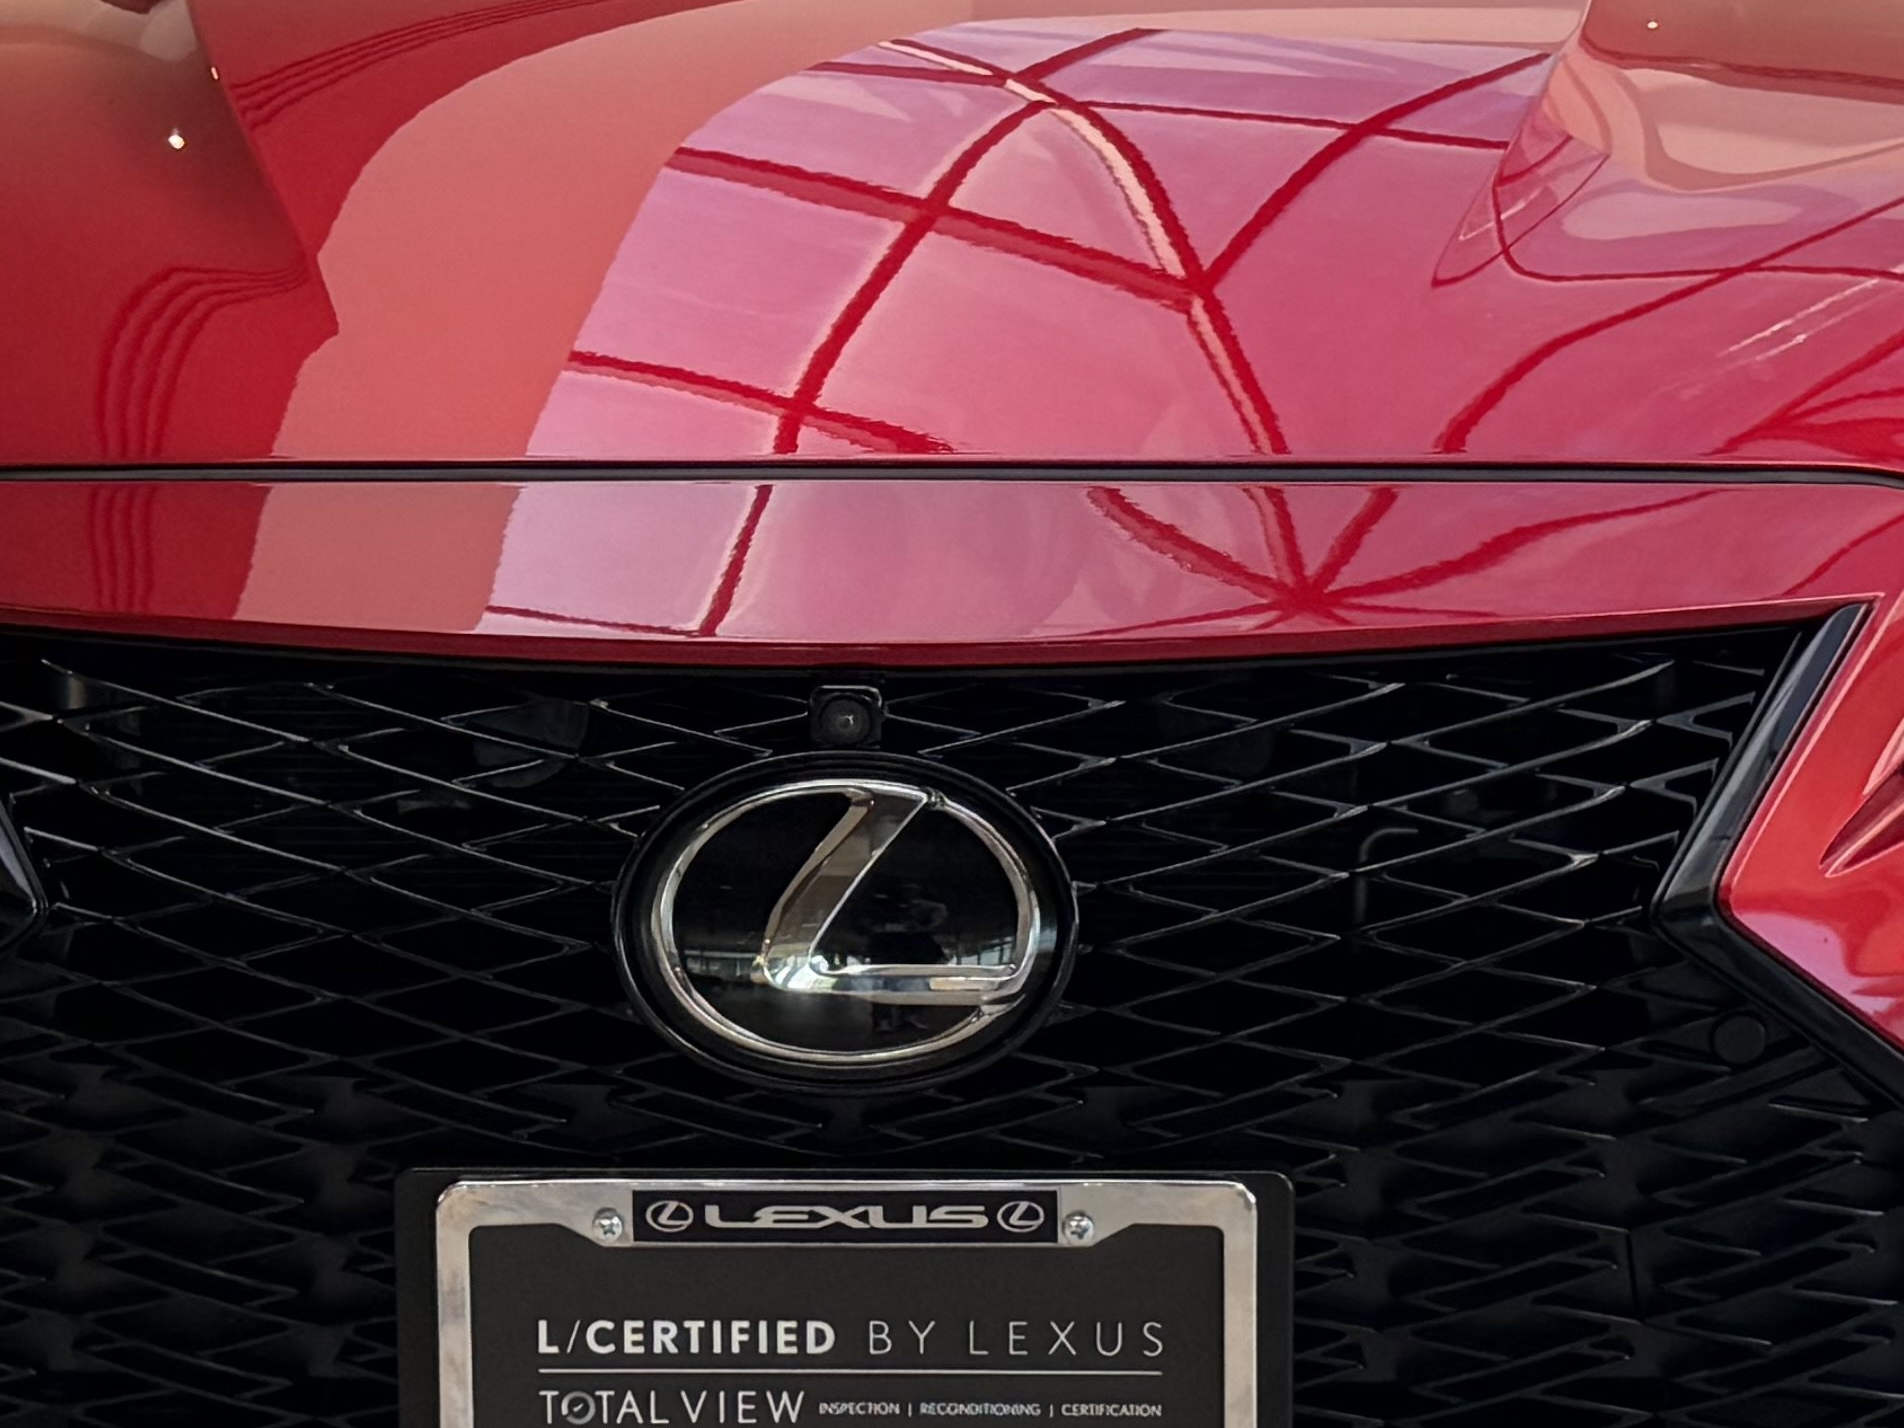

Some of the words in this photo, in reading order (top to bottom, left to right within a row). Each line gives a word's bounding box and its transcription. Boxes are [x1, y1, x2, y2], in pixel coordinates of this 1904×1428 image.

[705, 1204, 989, 1229] LEXUS
[538, 1320, 836, 1354] L/CERTIFIED
[869, 1320, 936, 1355] BY
[969, 1320, 1164, 1357] LEXUS
[538, 1390, 670, 1425] TOTAL
[680, 1390, 805, 1424] VIEW
[819, 1402, 900, 1416] INSPECTION
[919, 1402, 1042, 1417] RECONDITIONING
[1061, 1403, 1163, 1417] CERTIFICATION
